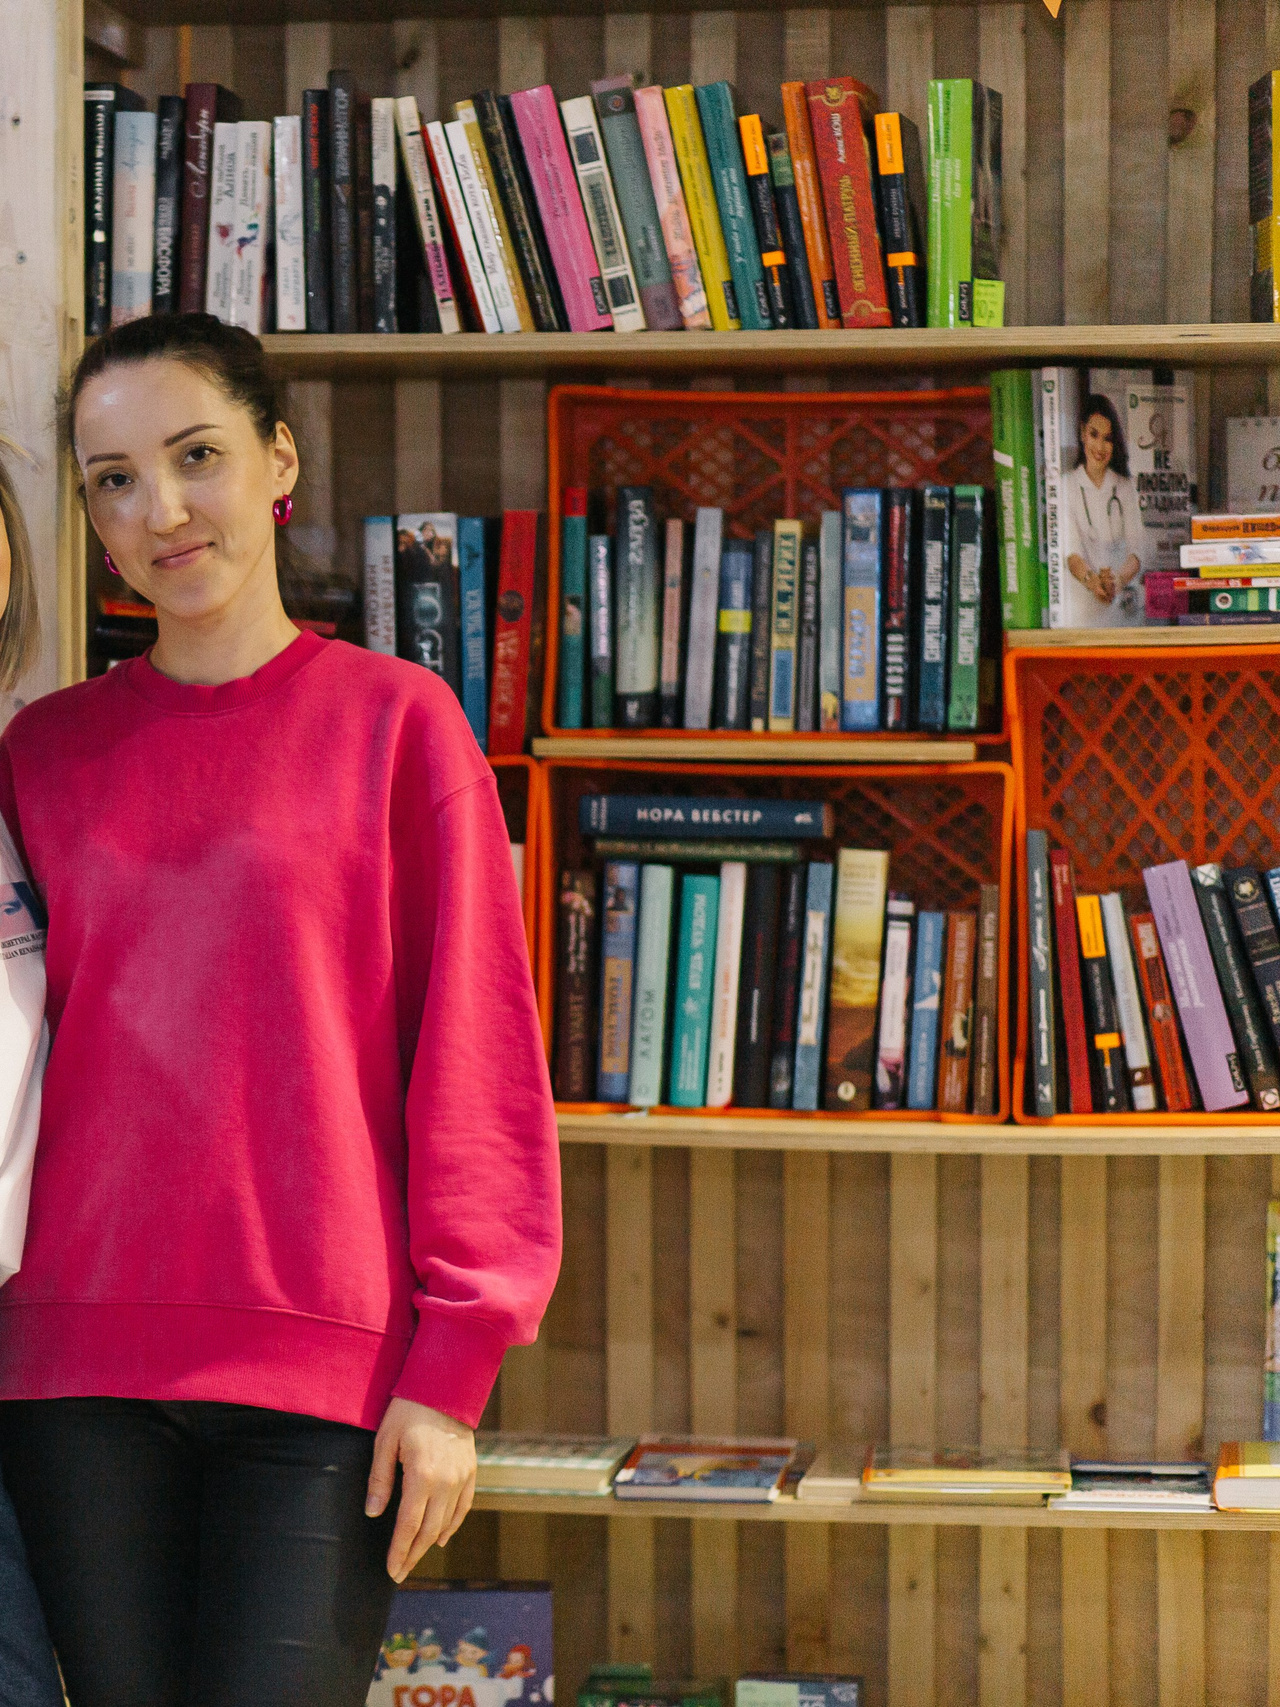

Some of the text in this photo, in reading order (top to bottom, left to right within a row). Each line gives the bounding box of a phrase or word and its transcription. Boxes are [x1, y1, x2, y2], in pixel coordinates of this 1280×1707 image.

[830, 112, 843, 137] КОШ
[839, 174, 867, 293] ОГНЕННЫЙ ПАТРУЛЬ
[1153, 449, 1171, 470] НЕ
[636, 808, 764, 824] НОРА ВЕБСТЕР
[638, 989, 655, 1062] ЛАГОМ
[393, 1684, 478, 1707] ГОРА
